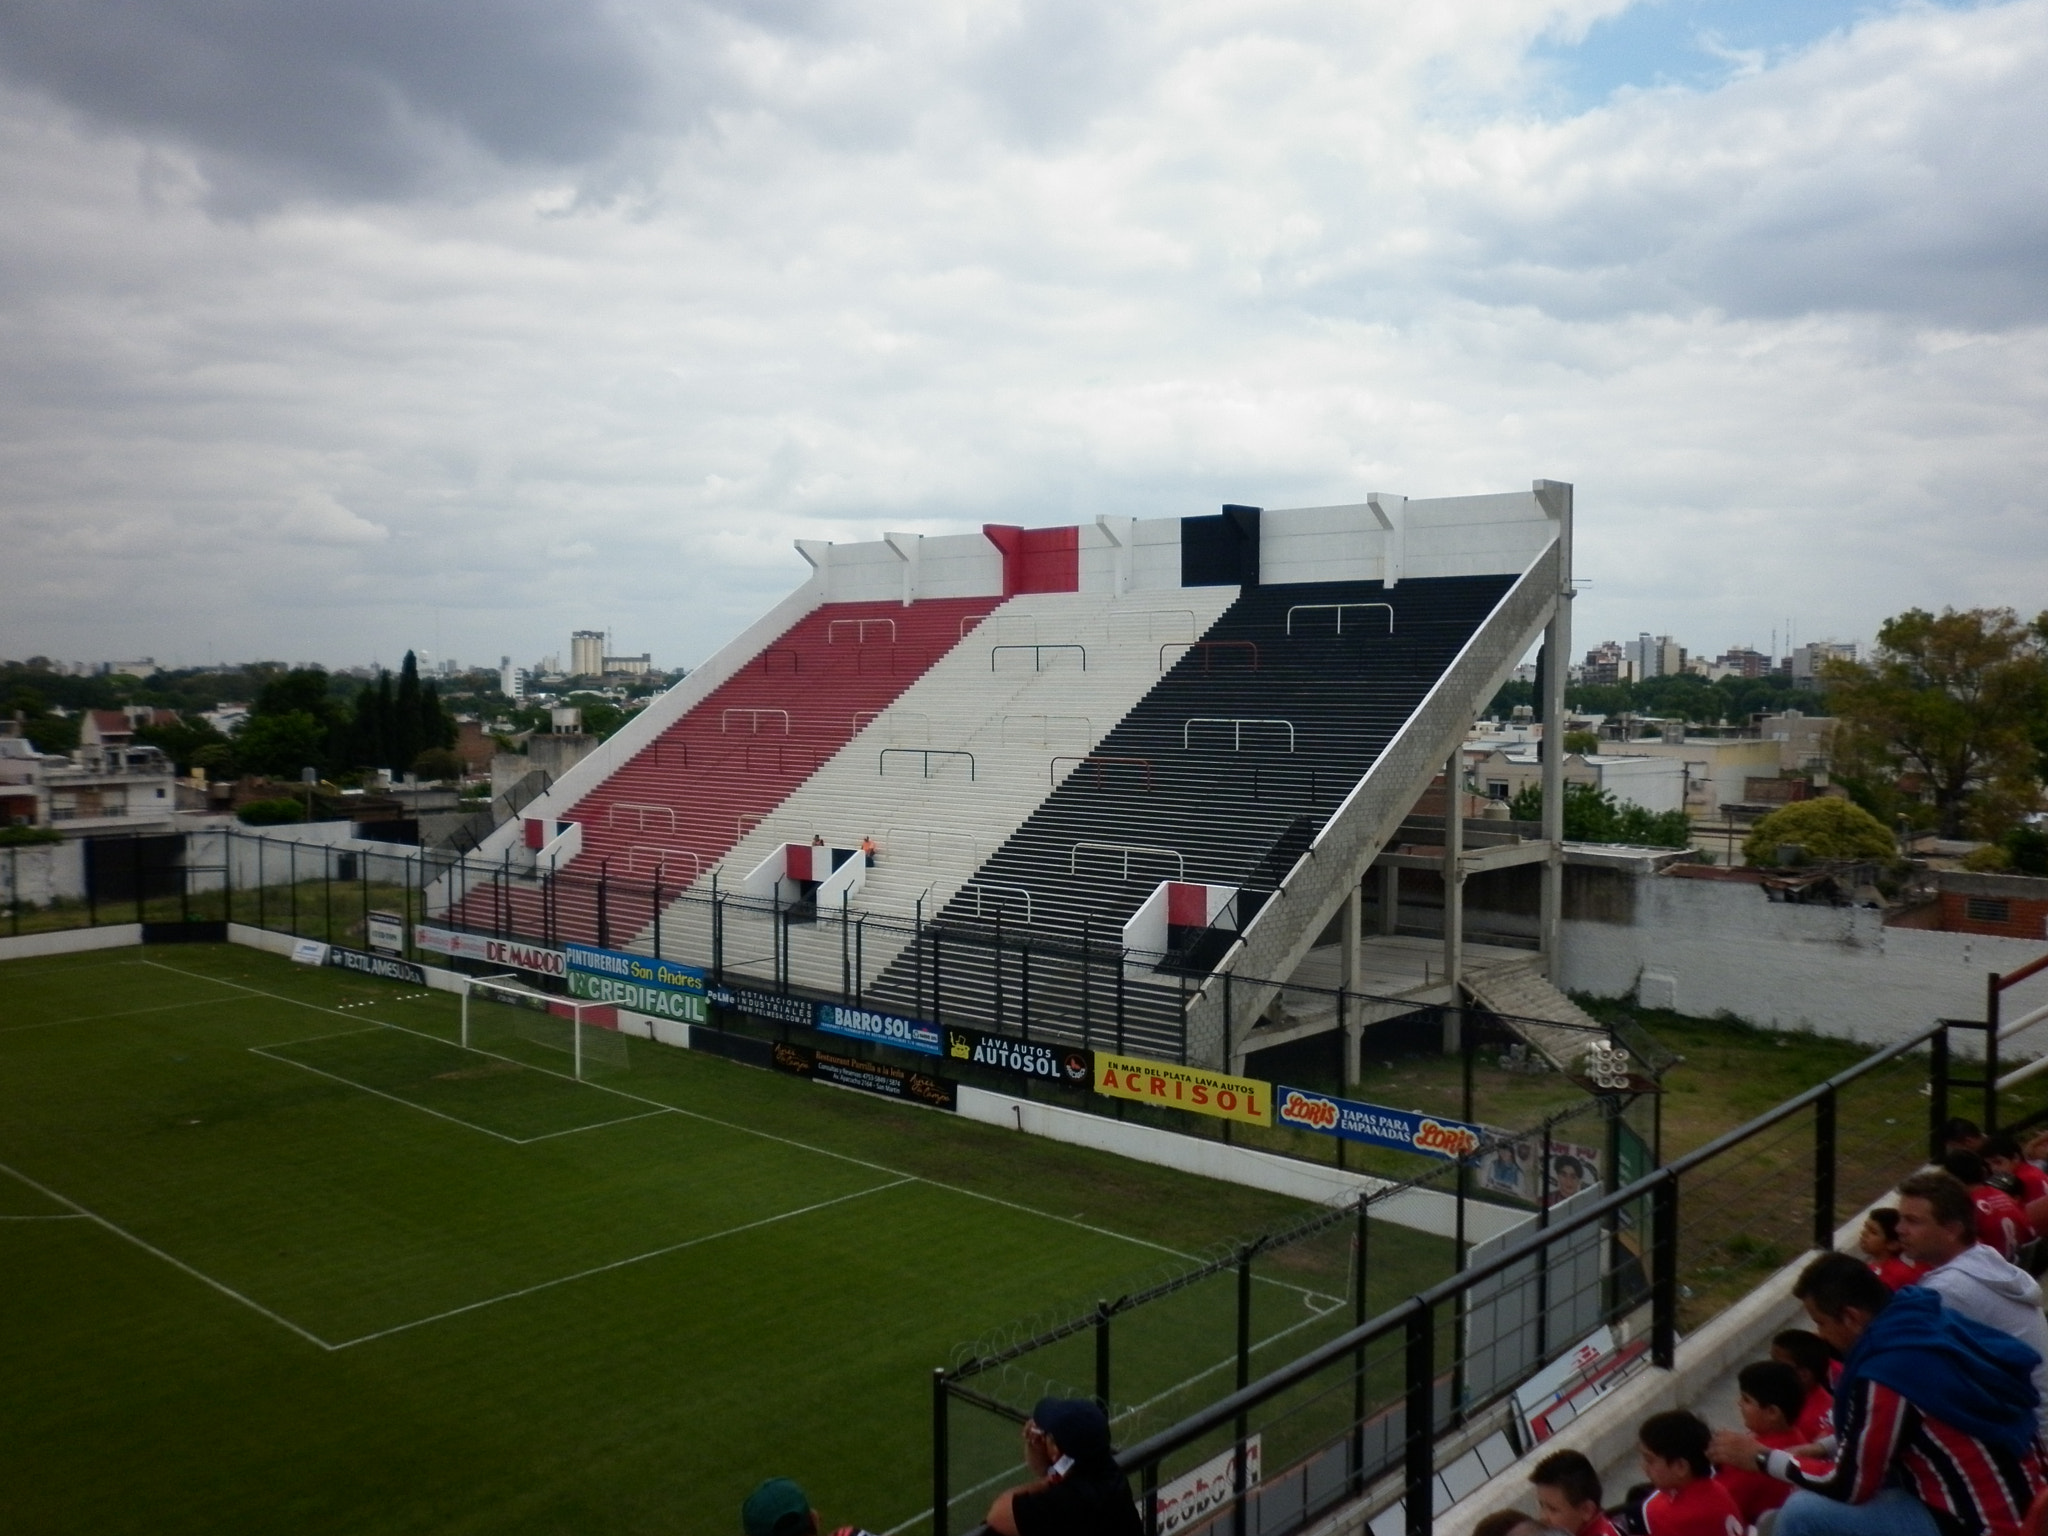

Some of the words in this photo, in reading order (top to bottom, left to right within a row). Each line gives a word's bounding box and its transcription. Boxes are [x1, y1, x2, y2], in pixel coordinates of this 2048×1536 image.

[343, 952, 371, 972] TEXTIL
[370, 959, 410, 981] AMESUD
[486, 940, 507, 963] DE
[509, 945, 565, 975] MARCO
[566, 947, 629, 975] PINTURERIAS
[630, 961, 653, 981] San
[658, 966, 703, 989] Andres
[588, 976, 704, 1022] CREDIFACIL
[737, 990, 812, 1010] NSTALACIONES
[737, 997, 812, 1018] INDUSTRIALES
[834, 1007, 882, 1033] BARRO
[884, 1017, 911, 1040] SOL
[973, 1045, 1061, 1078] AUTOSOL
[981, 1037, 1008, 1050] LAVA
[1014, 1043, 1051, 1058] AUTOS
[1102, 1069, 1262, 1117] ACRISOL
[1107, 1061, 1120, 1069] EN
[1121, 1063, 1142, 1073] MAR
[1144, 1067, 1161, 1077] DEL
[1163, 1071, 1192, 1083] PLATA
[1195, 1076, 1219, 1088] LAVA
[1220, 1083, 1255, 1095] AUTOS
[1340, 1119, 1412, 1143] EMPANADAS
[1341, 1108, 1377, 1127] TAPAS
[1379, 1116, 1409, 1132] PARA
